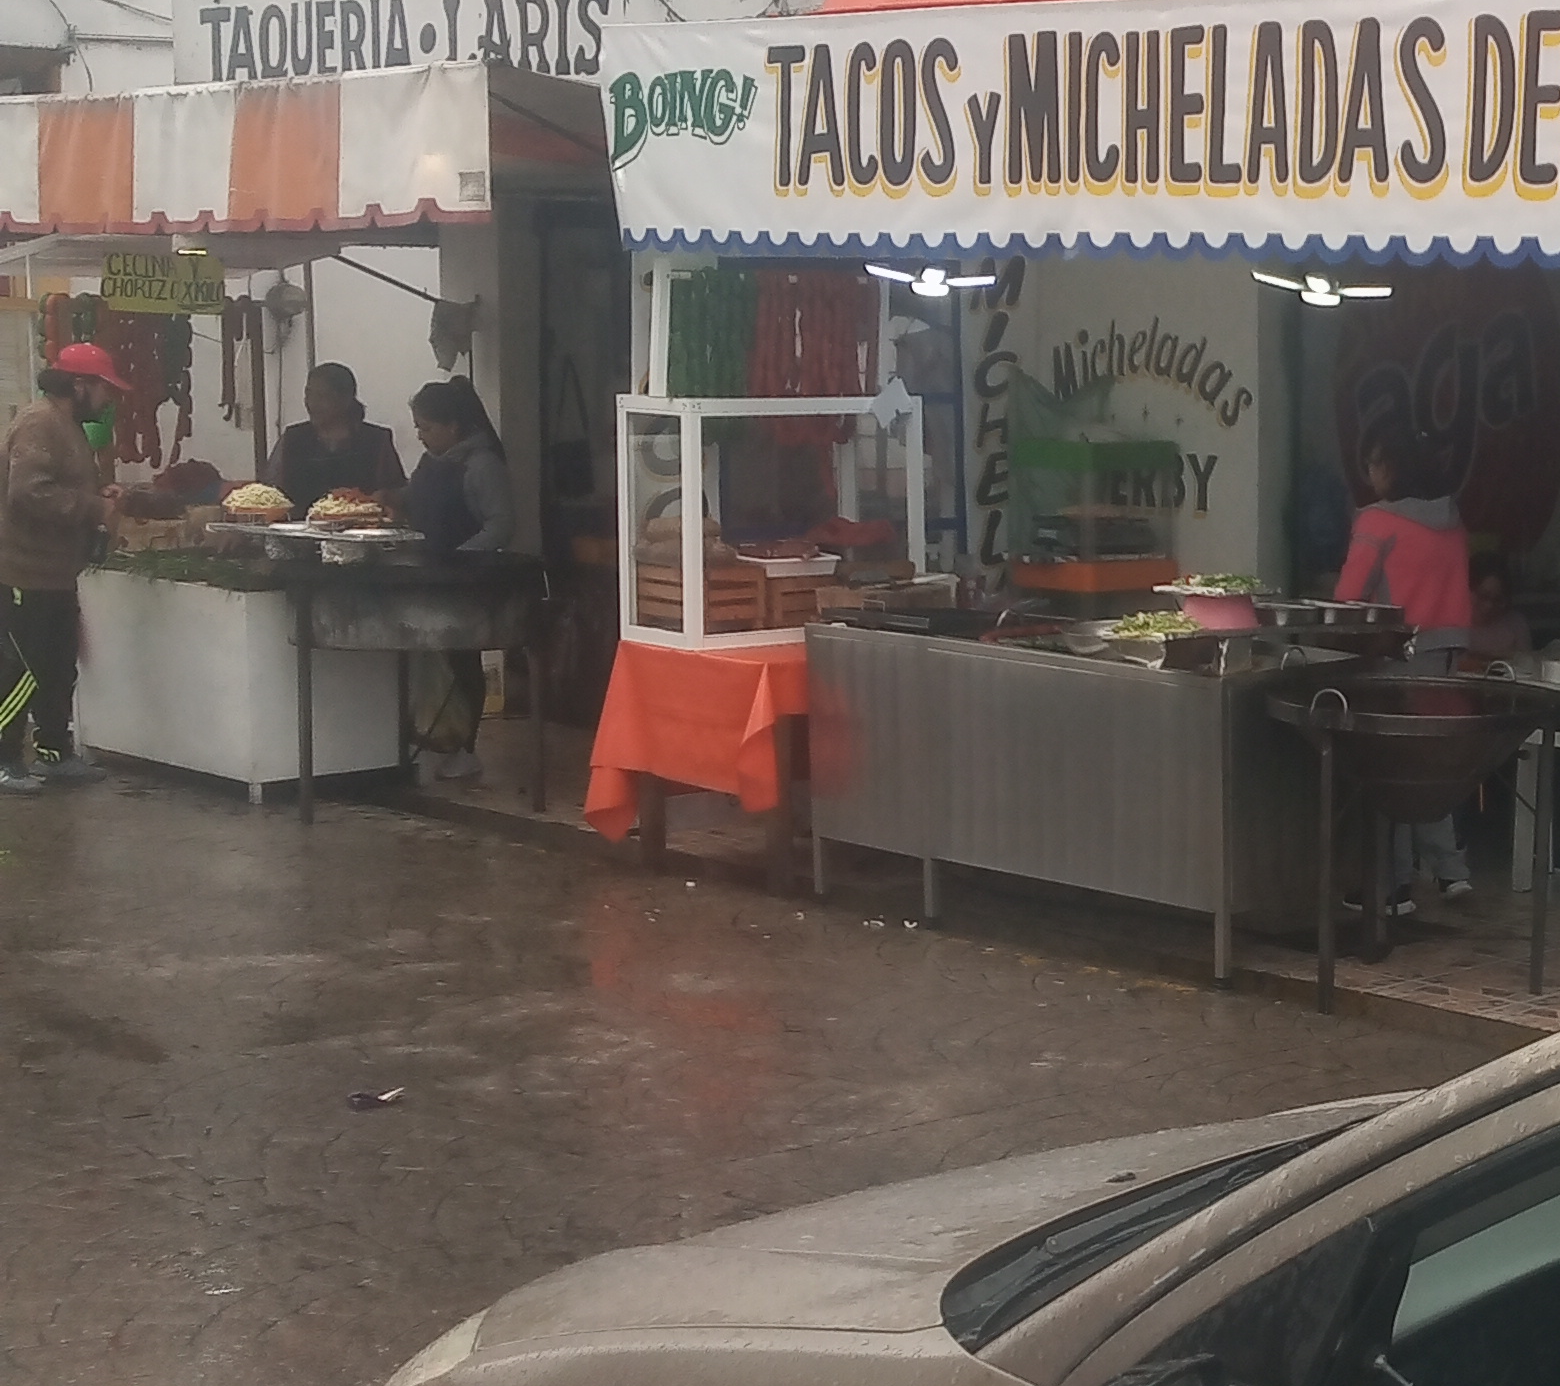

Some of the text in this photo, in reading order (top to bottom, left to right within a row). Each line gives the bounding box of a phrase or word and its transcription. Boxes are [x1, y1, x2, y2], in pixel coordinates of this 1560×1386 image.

[609, 69, 758, 172] BOING!
[763, 37, 962, 198] TACOS
[1001, 16, 1450, 200] MICHELADAS
[106, 253, 176, 279] CECINA
[1052, 315, 1255, 429] Micheladas
[1104, 452, 1218, 519] ERBY
